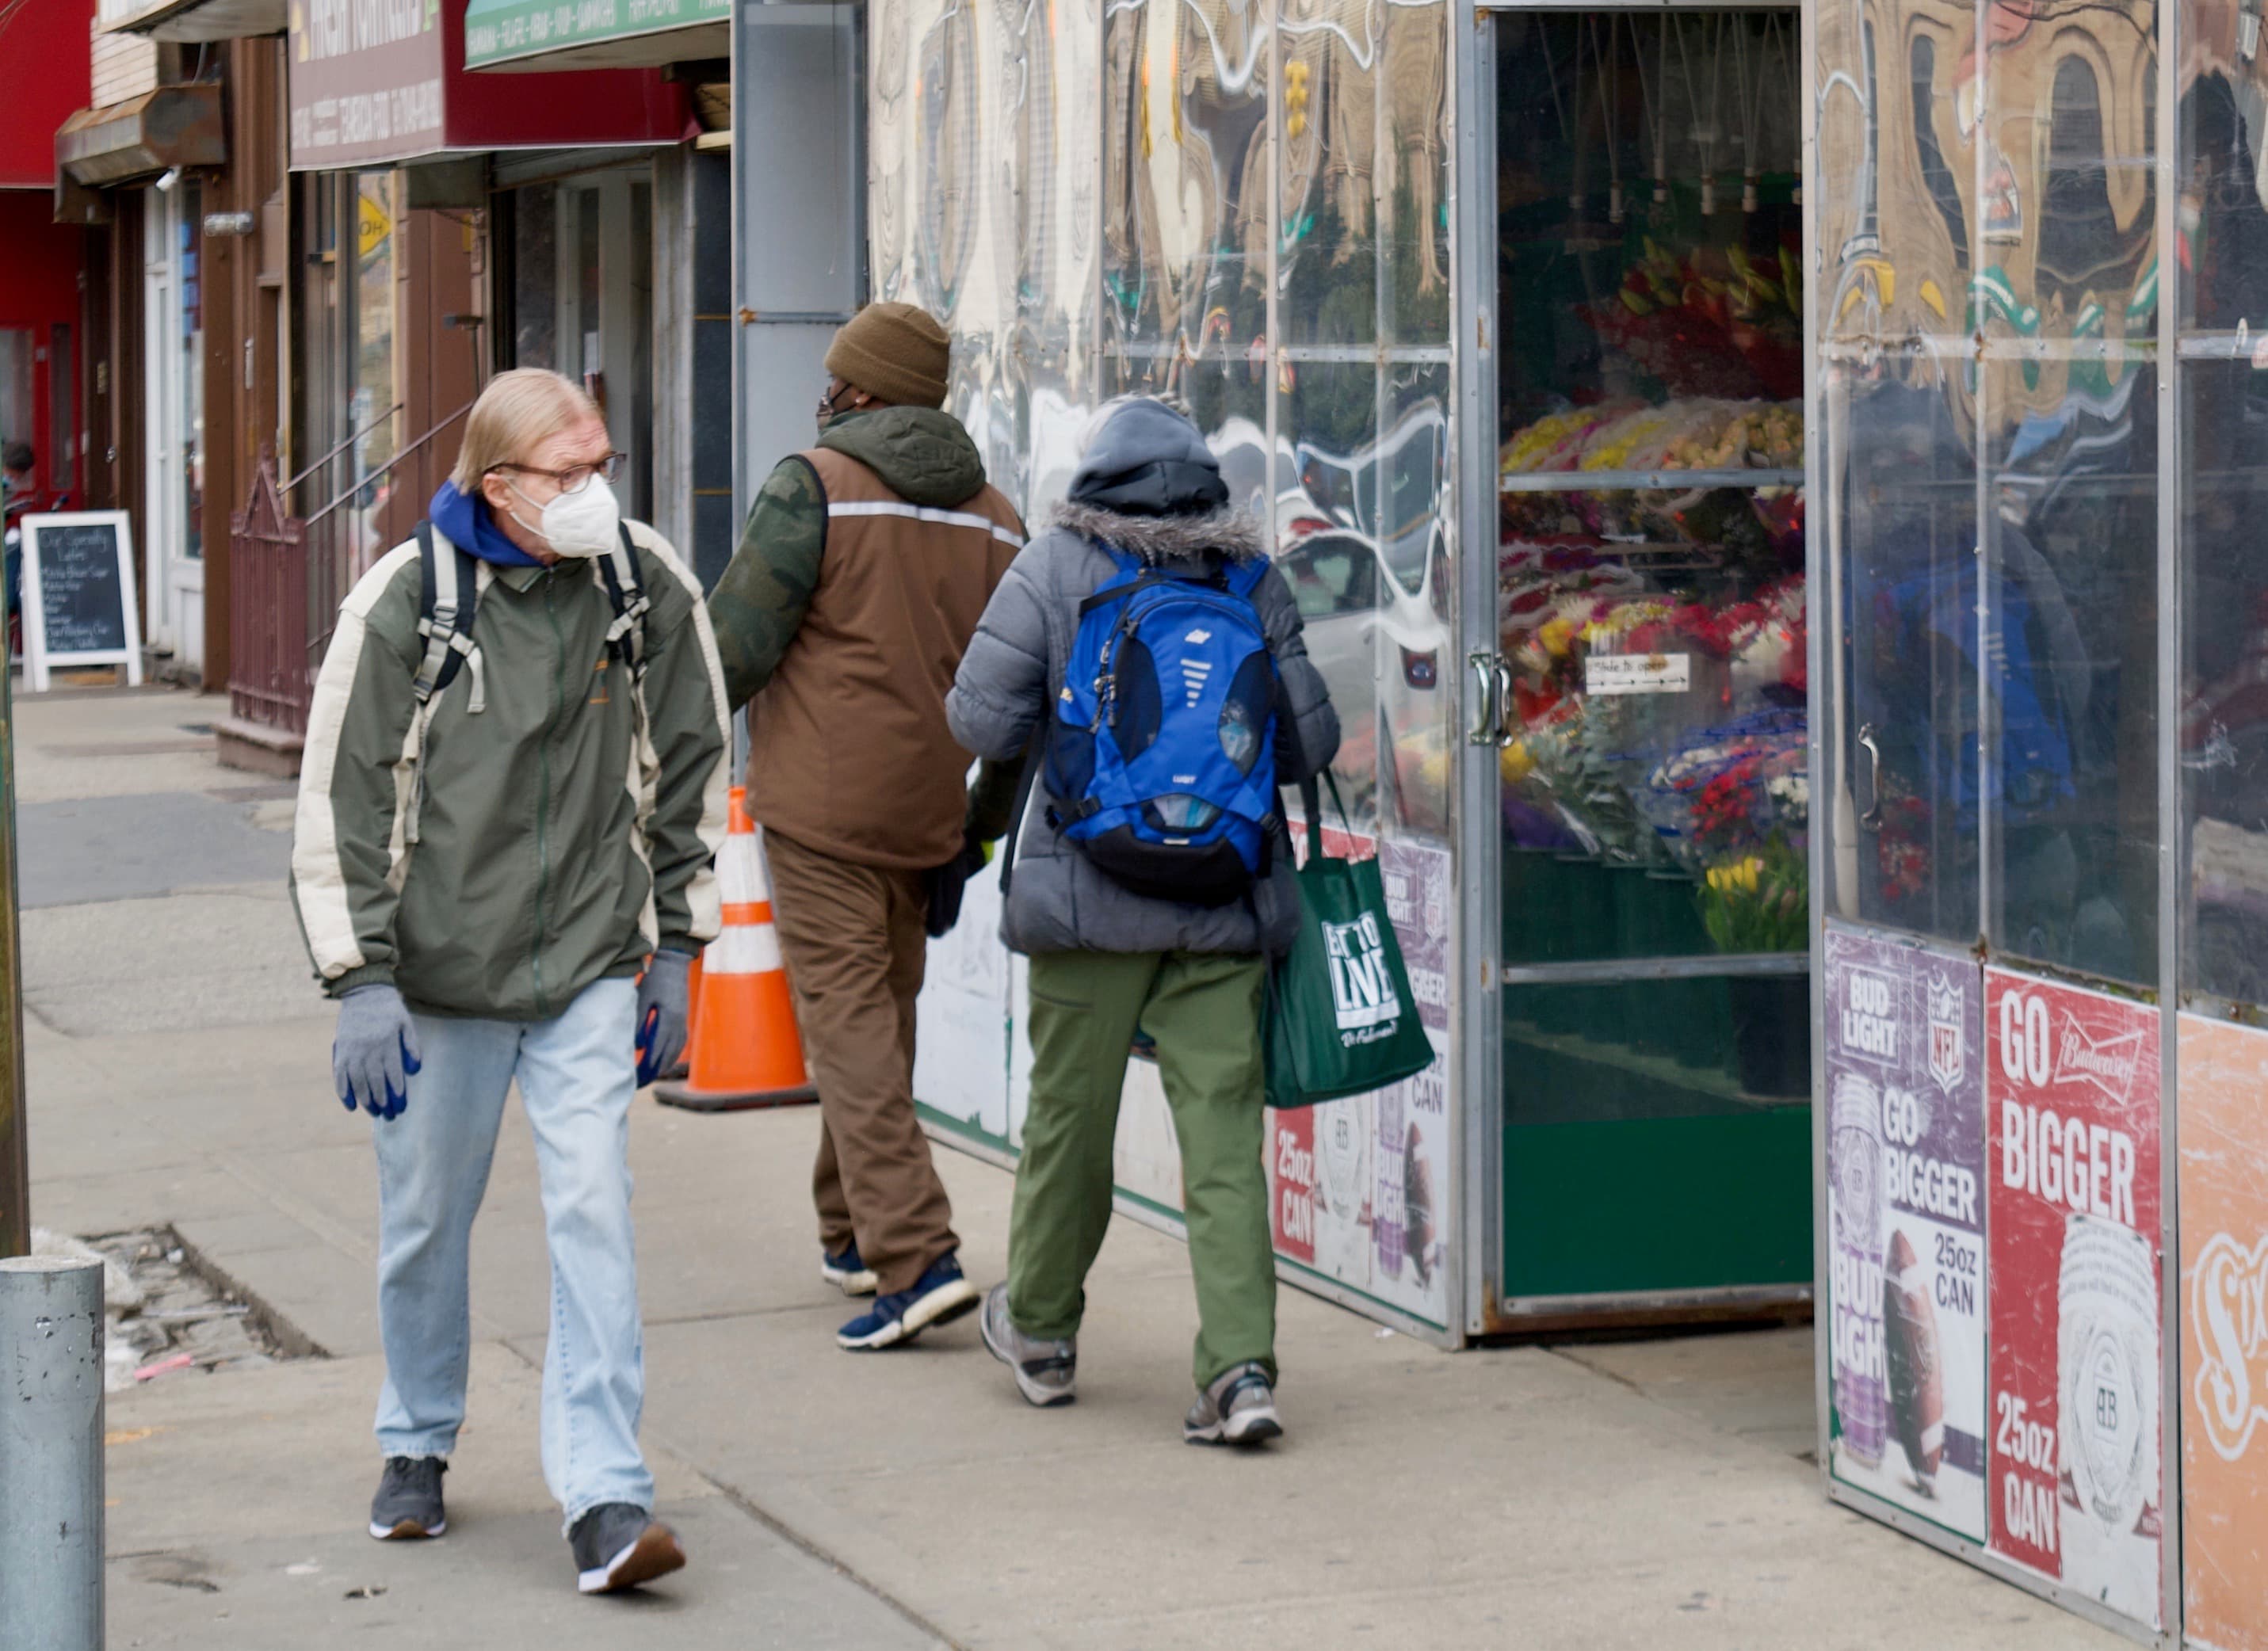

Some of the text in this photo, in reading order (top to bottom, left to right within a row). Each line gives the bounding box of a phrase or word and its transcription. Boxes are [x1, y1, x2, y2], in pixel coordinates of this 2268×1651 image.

[1387, 898, 1414, 923] IGHT
[1850, 973, 1889, 1018] BUD
[1842, 1009, 1897, 1058] LIGHT
[1931, 1025, 1961, 1076] NFL
[1999, 989, 2050, 1089] GO
[2060, 1031, 2137, 1087] Budweiser
[1412, 1073, 1444, 1116] CAN
[1882, 1088, 1919, 1147] GO
[1885, 1146, 1977, 1226] BIGGER
[2001, 1099, 2136, 1227] BIGGER
[1281, 1188, 1313, 1246] CAN
[1835, 1251, 1884, 1318] BUD
[1935, 1272, 1974, 1317] CAN
[2003, 1471, 2056, 1554] CAN
